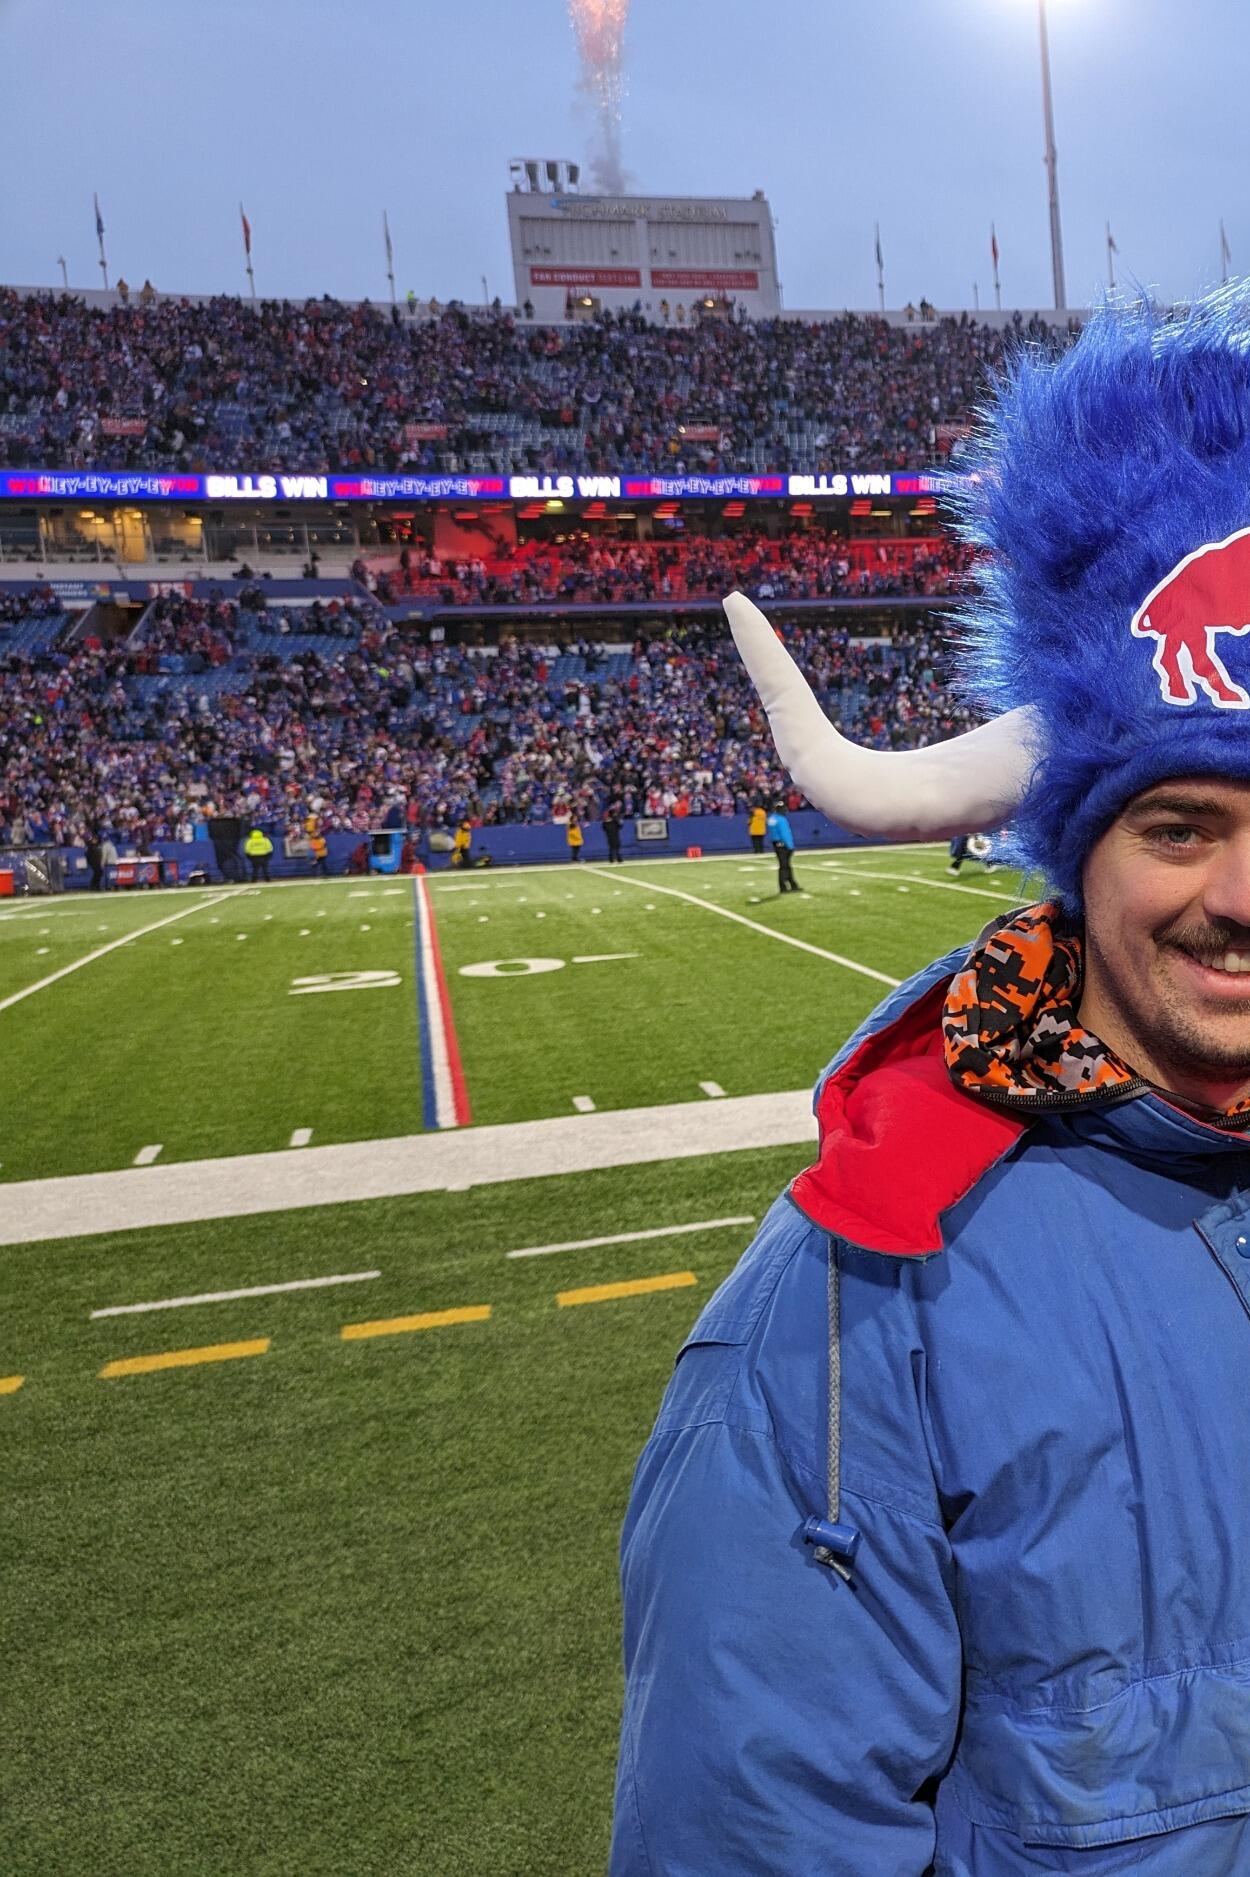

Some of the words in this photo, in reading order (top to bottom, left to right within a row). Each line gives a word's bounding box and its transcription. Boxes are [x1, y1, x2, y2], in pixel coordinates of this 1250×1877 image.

[206, 475, 277, 498] BILLS
[279, 475, 328, 498] WIN
[509, 475, 574, 497] BILLS
[576, 475, 621, 497] WIN
[788, 474, 848, 496] BILLS
[850, 474, 891, 496] WIN
